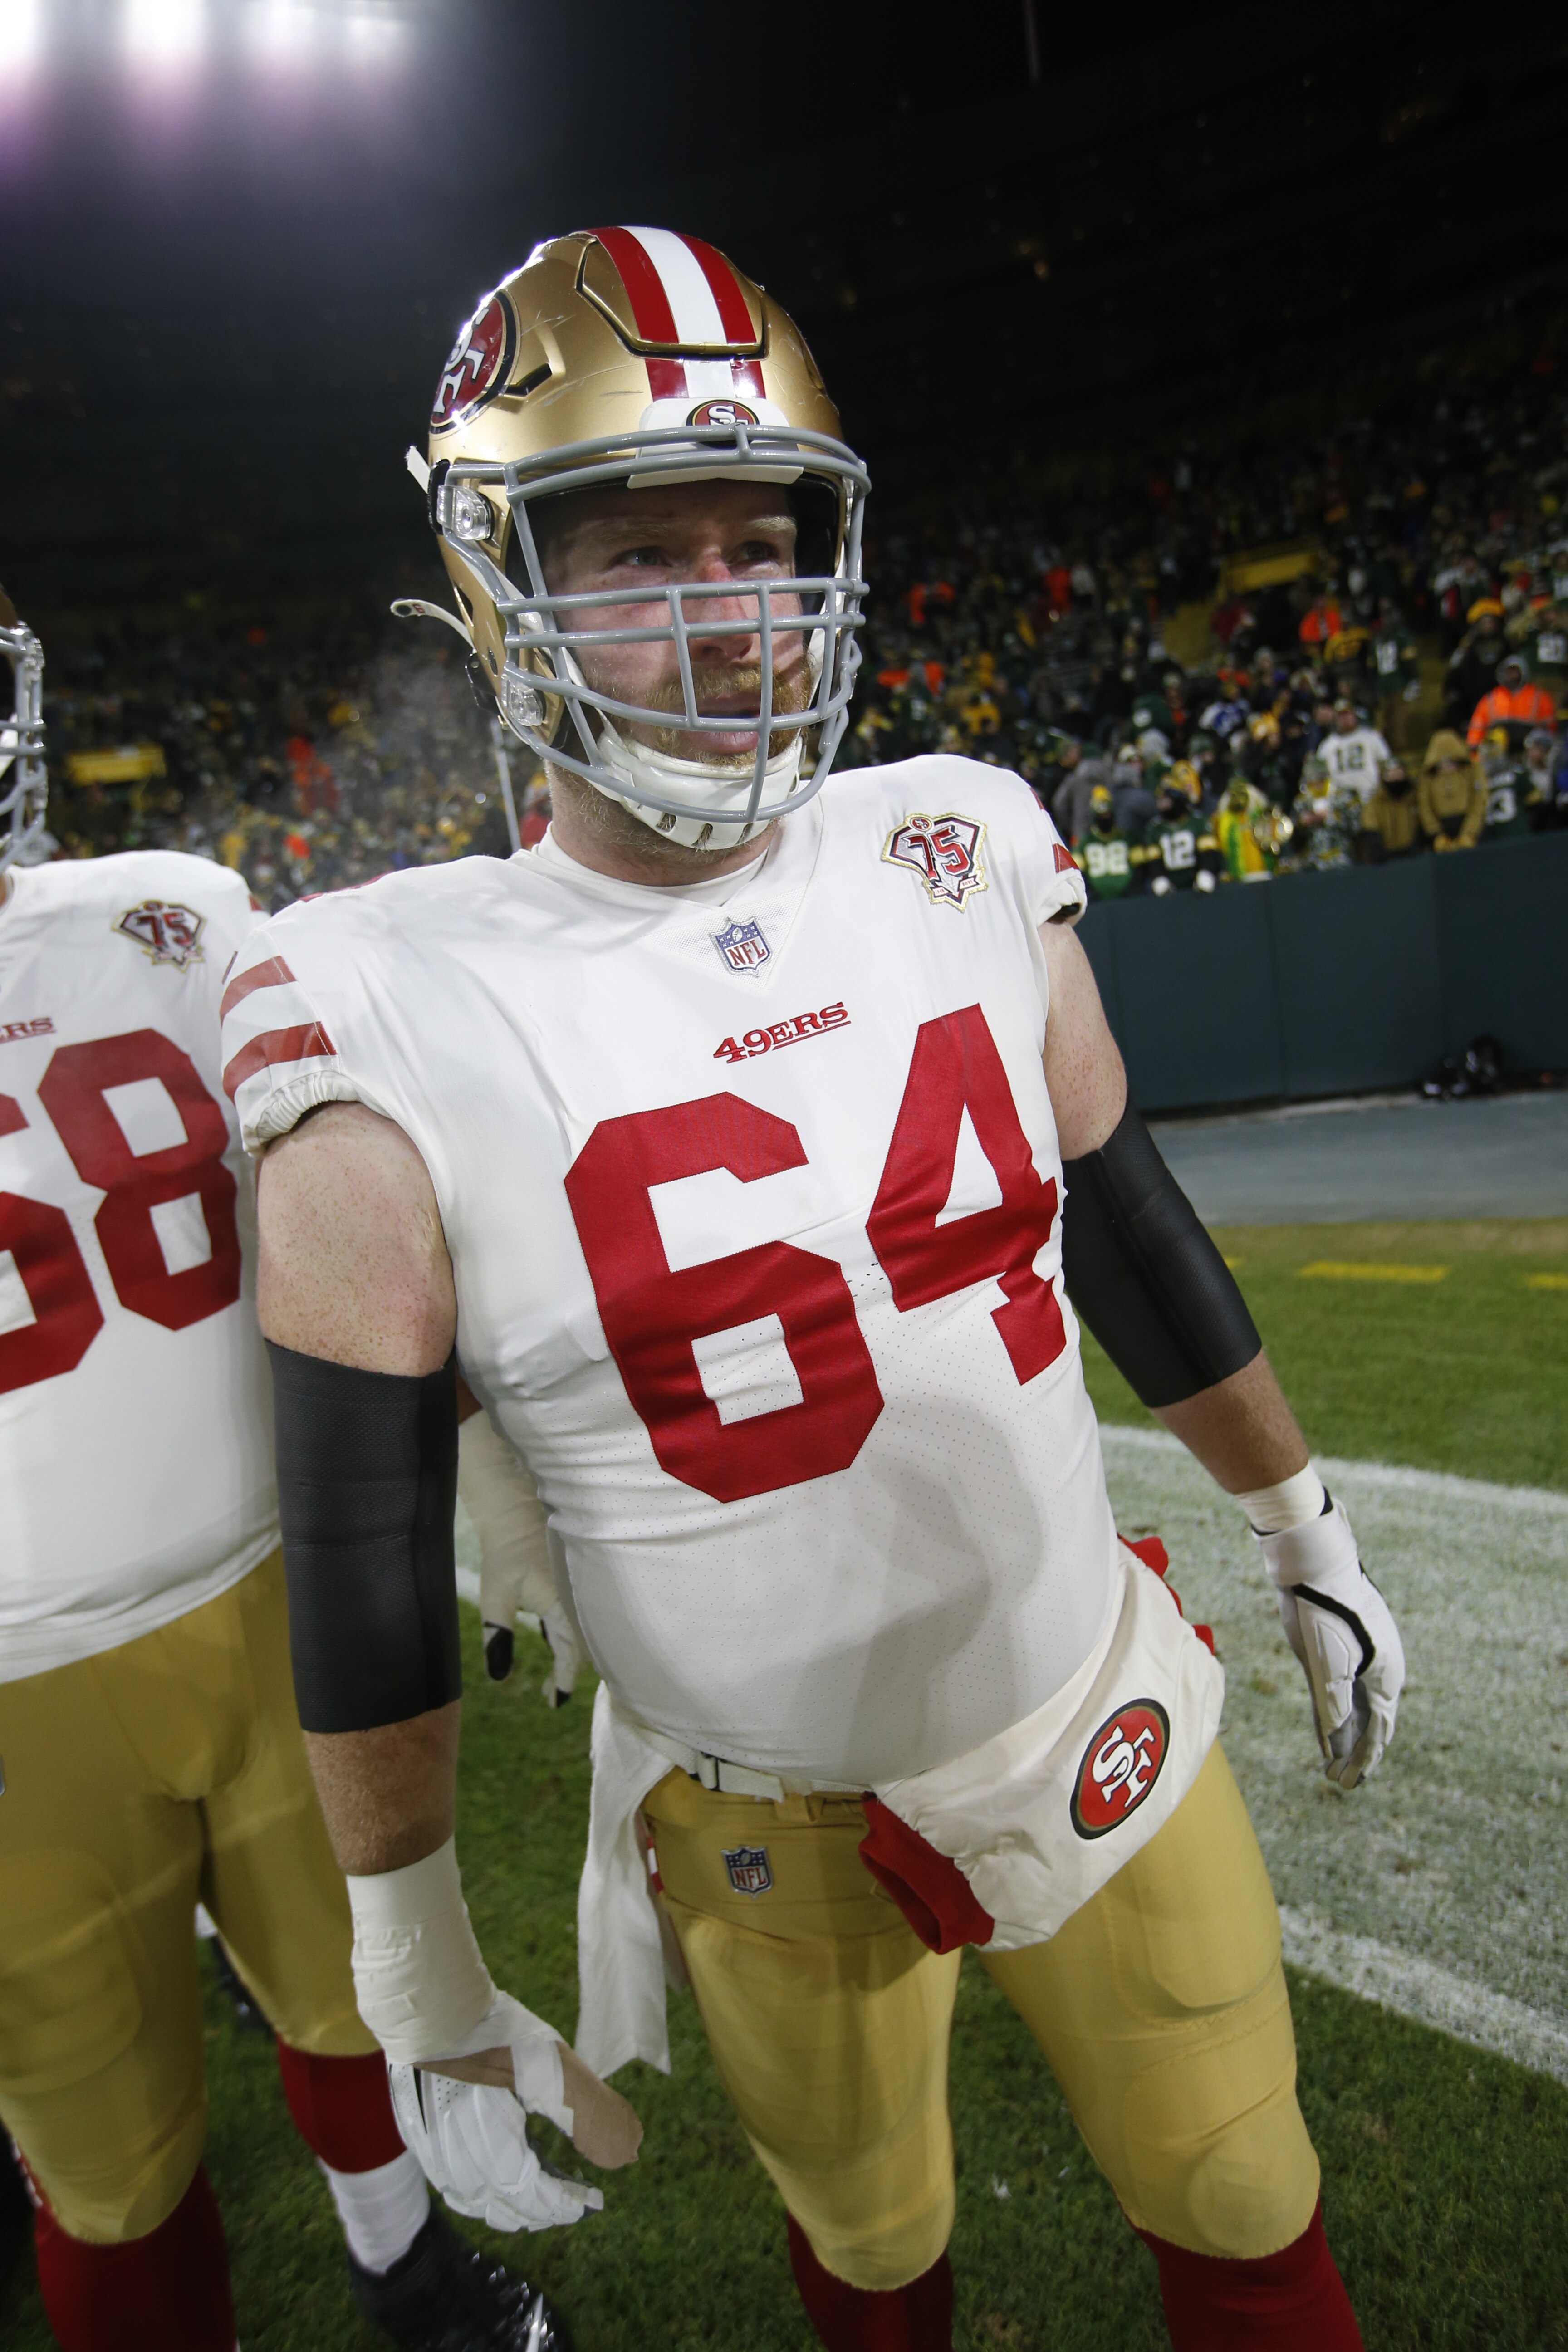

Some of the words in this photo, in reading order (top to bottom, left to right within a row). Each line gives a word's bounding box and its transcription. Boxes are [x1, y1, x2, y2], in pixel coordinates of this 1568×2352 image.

[905, 826, 974, 882] 75
[1159, 830, 1196, 871] 12
[136, 912, 191, 948] 75
[727, 939, 766, 966] NFL
[713, 1002, 851, 1063] 49ERS
[564, 1003, 1067, 1504] 64
[733, 1867, 767, 1888] NFL
